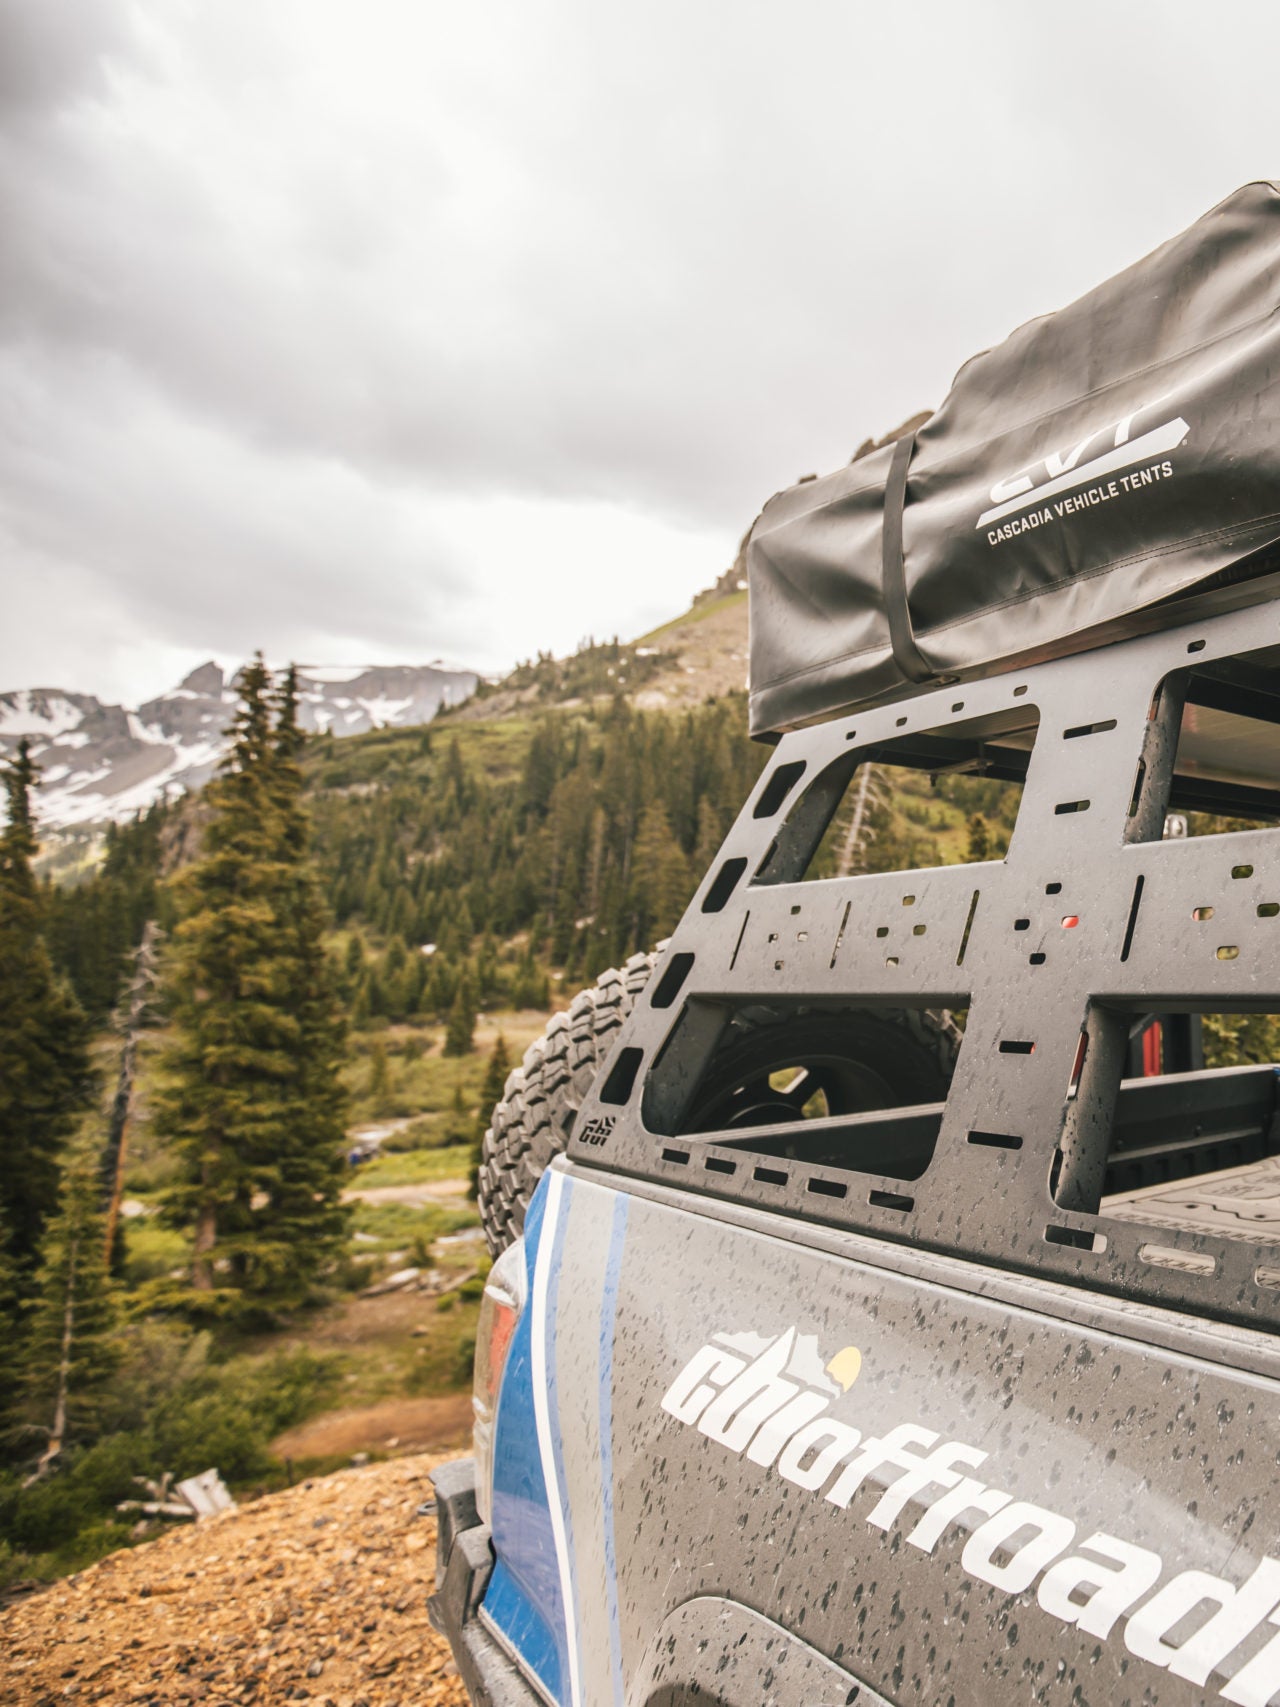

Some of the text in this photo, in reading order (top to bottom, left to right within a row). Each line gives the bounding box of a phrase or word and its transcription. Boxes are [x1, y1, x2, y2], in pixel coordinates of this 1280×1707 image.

[987, 461, 1174, 546] CASCADIA VEHICLE TENTS
